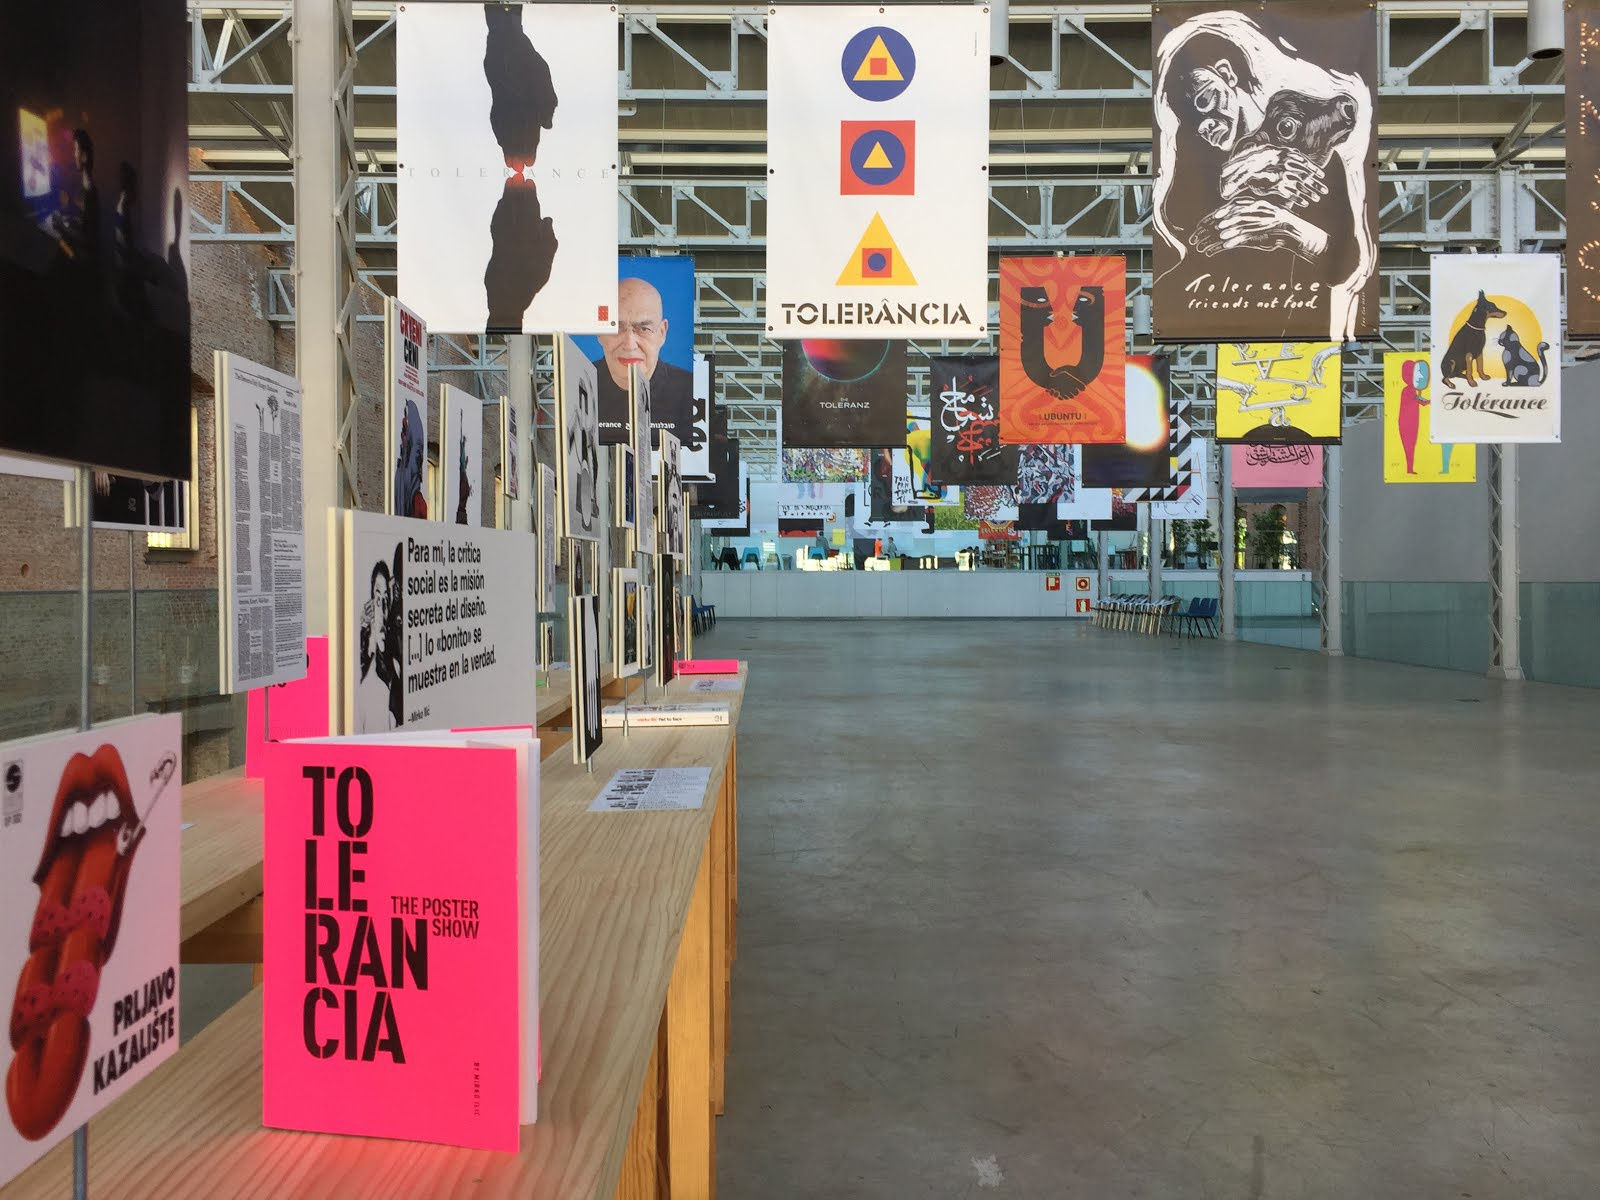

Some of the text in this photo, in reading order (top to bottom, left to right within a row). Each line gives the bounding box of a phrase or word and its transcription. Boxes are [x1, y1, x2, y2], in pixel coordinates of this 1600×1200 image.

[407, 166, 610, 179] TOLERANCE
[1185, 273, 1320, 293] Tolerance
[781, 298, 971, 325] TOLERÂNCIA
[1188, 294, 1318, 309] friends not food
[819, 401, 871, 409] TOLERANZ
[1441, 391, 1549, 419] Tolérance
[408, 537, 430, 563] Para
[448, 540, 456, 562] la
[407, 569, 485, 595] social es la misión
[407, 595, 487, 628] secreta del diseño.
[425, 632, 434, 656] lo
[437, 626, 472, 652] «bonito»
[473, 627, 482, 644] se
[408, 644, 497, 694] muestra en la verdad.
[303, 766, 374, 838] TO
[305, 839, 368, 912] LE
[391, 895, 479, 919] THE POSTER
[432, 918, 480, 940] SHOW
[305, 913, 428, 990] RAN
[113, 966, 175, 1037] PRLJAVO
[303, 986, 407, 1064] CIA
[93, 1006, 175, 1096] KAZALIŠTE
